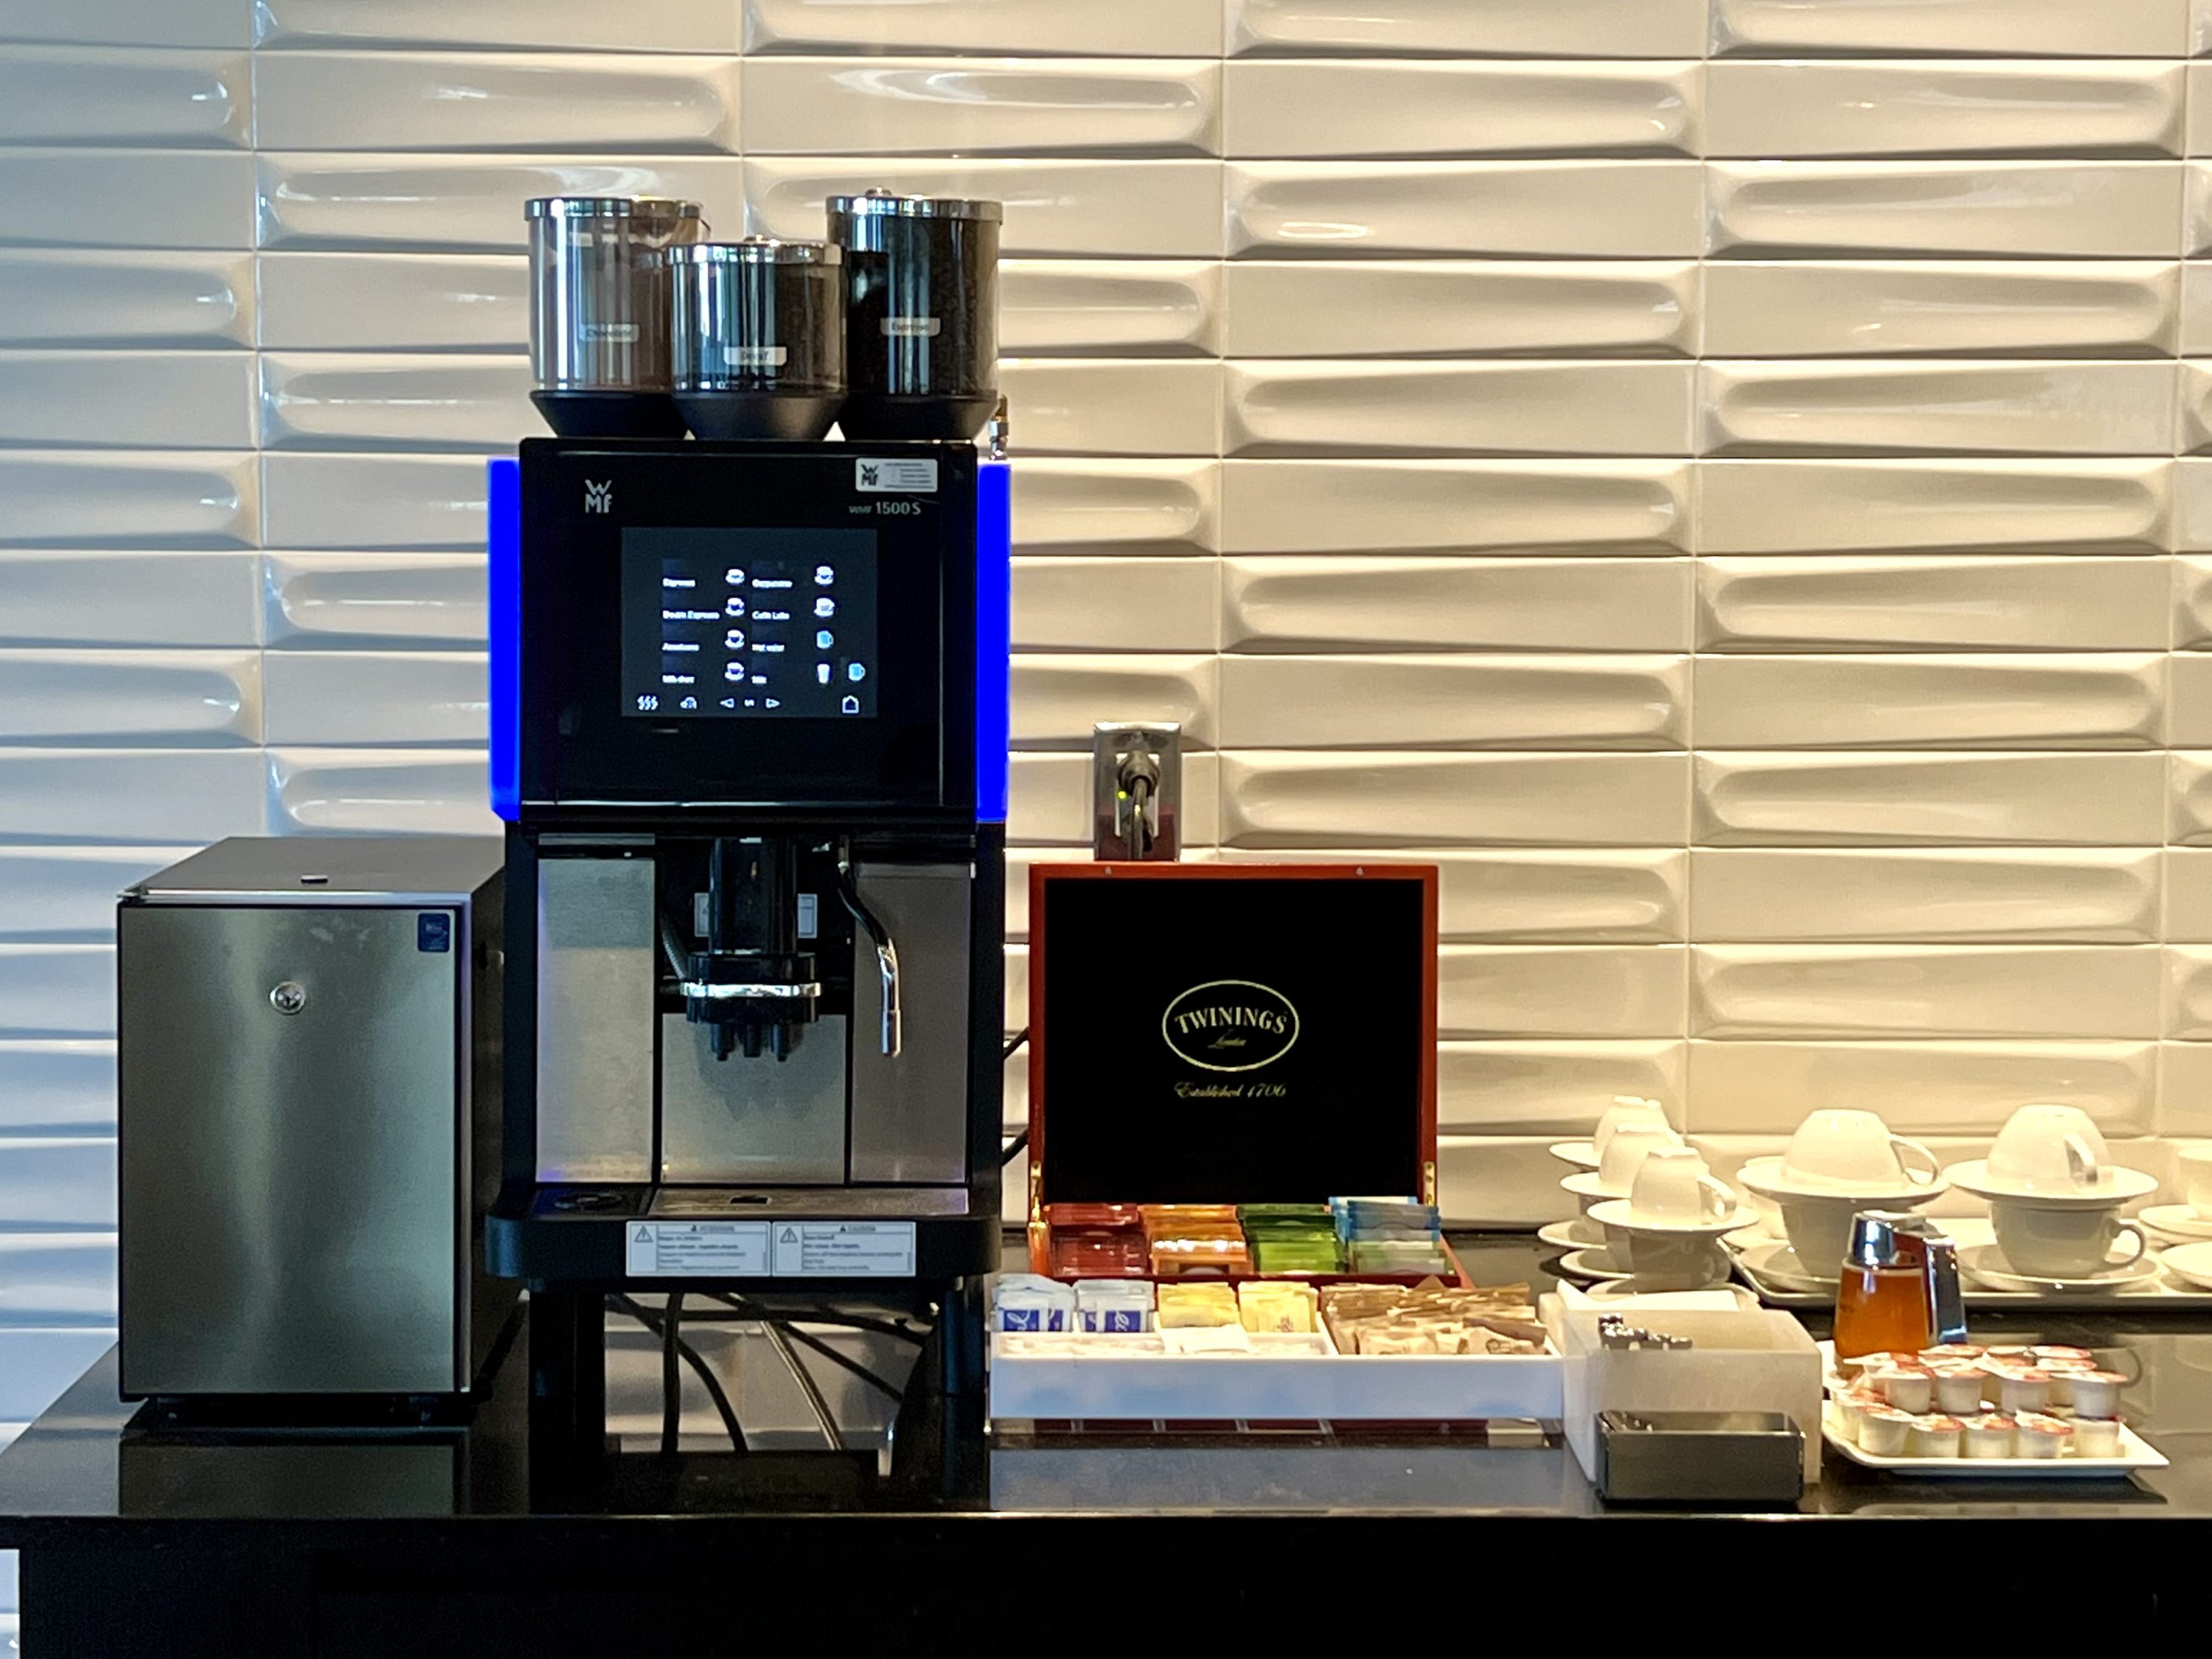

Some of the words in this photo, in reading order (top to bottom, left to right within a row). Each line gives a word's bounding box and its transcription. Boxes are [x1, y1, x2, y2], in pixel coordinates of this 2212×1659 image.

[876, 501, 910, 515] 1500
[1175, 1006, 1287, 1034] TWININGS
[1174, 1082, 1244, 1098] Established
[1247, 1082, 1287, 1098] 1706
